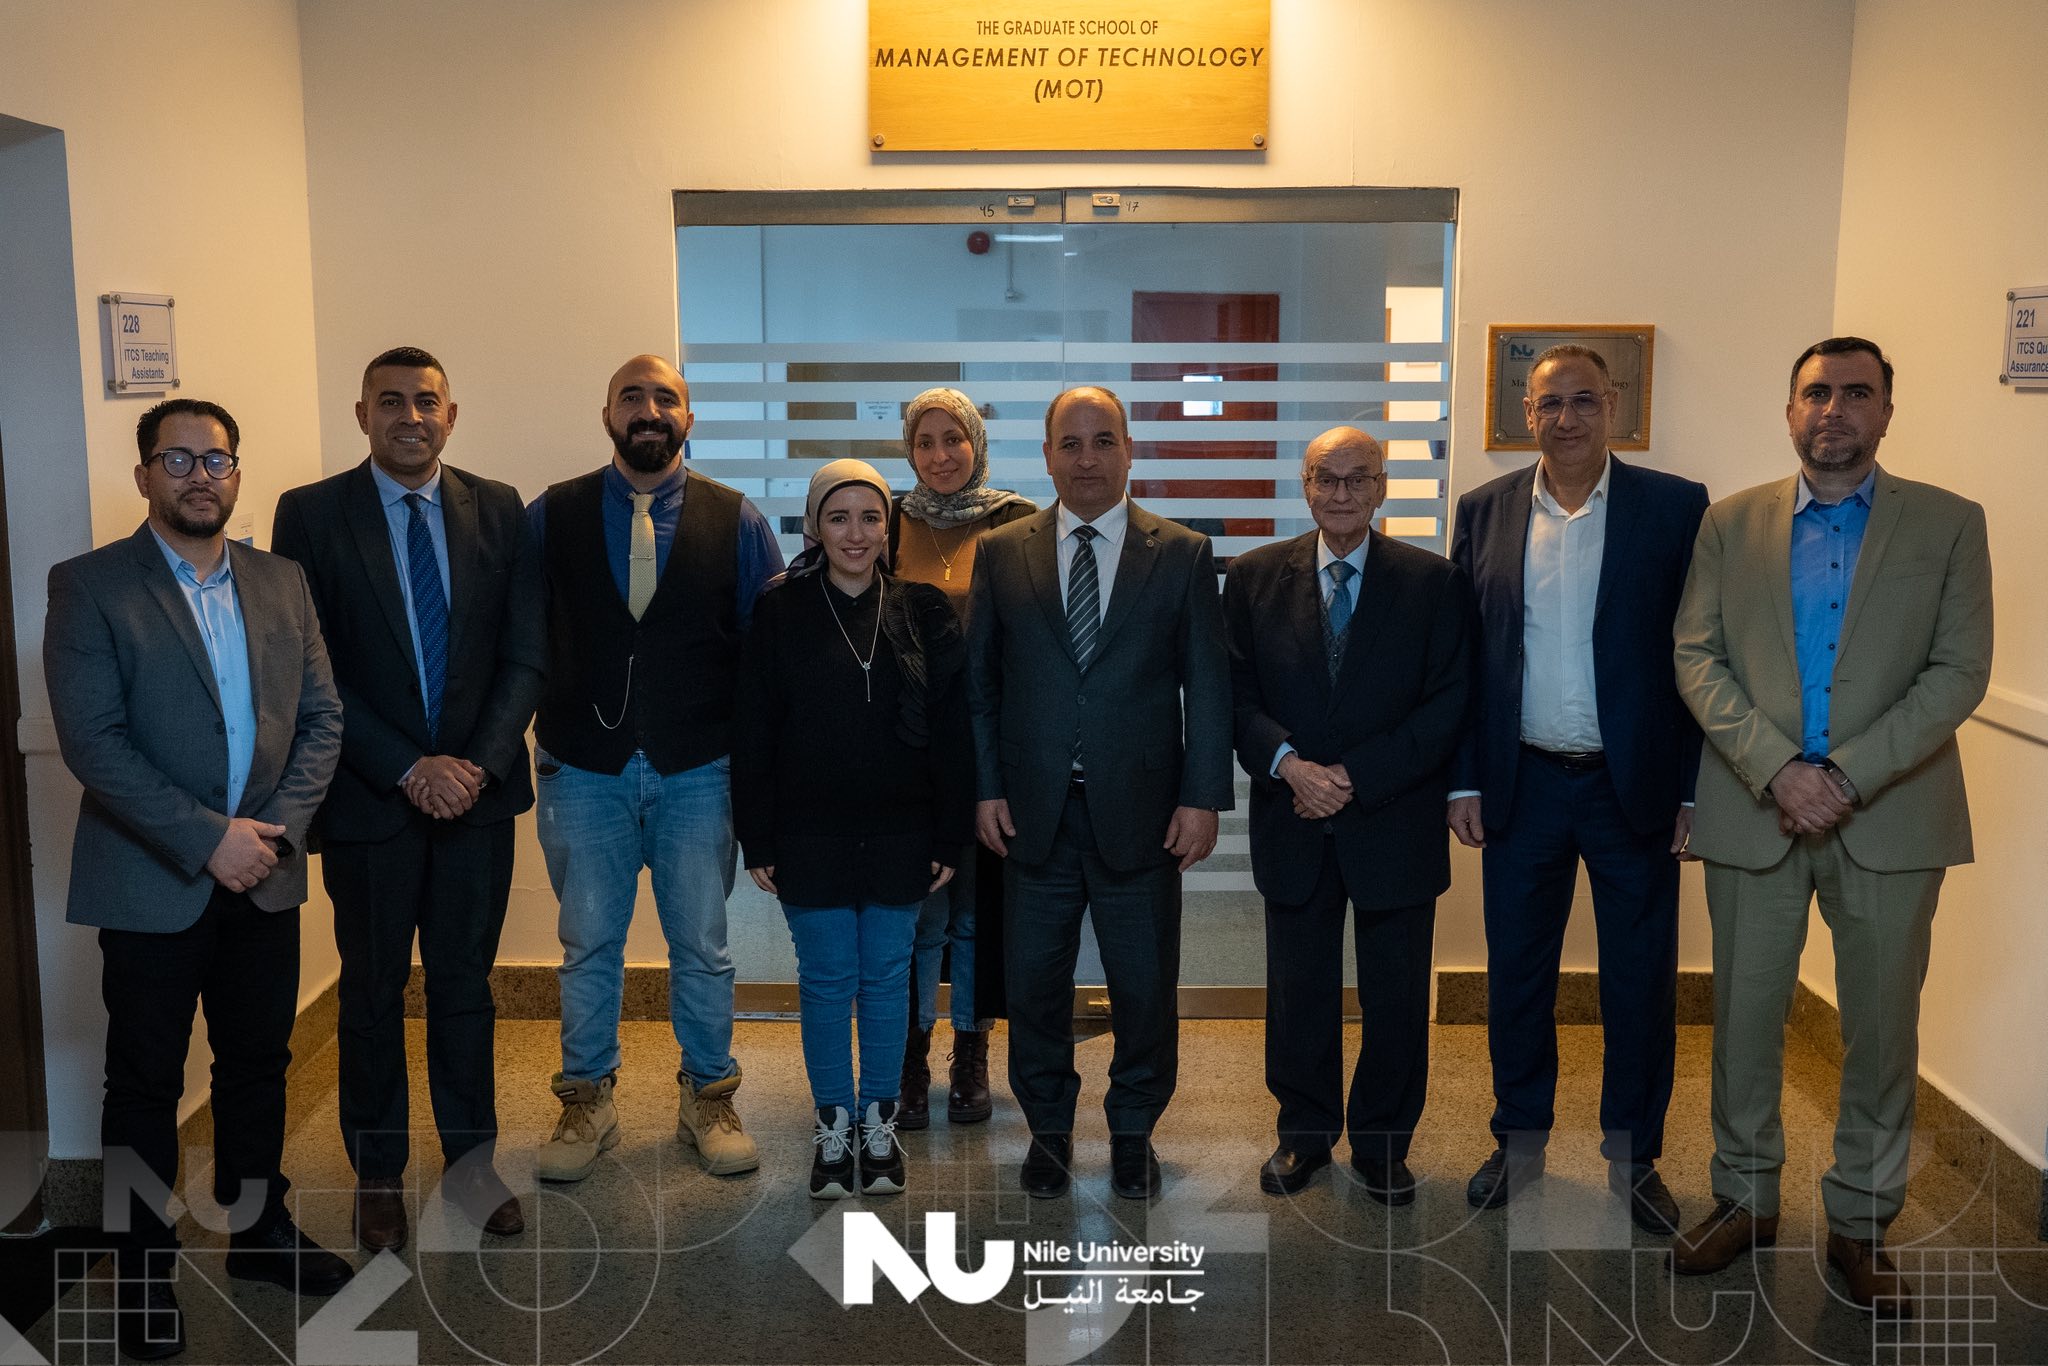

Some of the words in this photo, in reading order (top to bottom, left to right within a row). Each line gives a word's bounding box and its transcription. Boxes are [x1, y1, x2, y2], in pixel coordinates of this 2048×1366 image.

[977, 21, 999, 35] THE
[1003, 21, 1075, 35] GRADUATE
[1079, 21, 1136, 35] SCHOOL
[1140, 21, 1158, 35] OF
[875, 47, 1049, 68] MANAGEMENT
[1057, 47, 1089, 67] OF
[1097, 46, 1265, 68] TECHNOLOGY
[1034, 79, 1104, 103] (MOT)
[122, 314, 140, 333] 228
[2016, 308, 2035, 328] 221
[2016, 342, 2035, 355] ITCS
[2036, 341, 2048, 355] Qu
[124, 349, 140, 361] ITCS
[141, 349, 169, 364] Teaching
[131, 367, 165, 379] Assistants
[2010, 360, 2048, 373] Assurance
